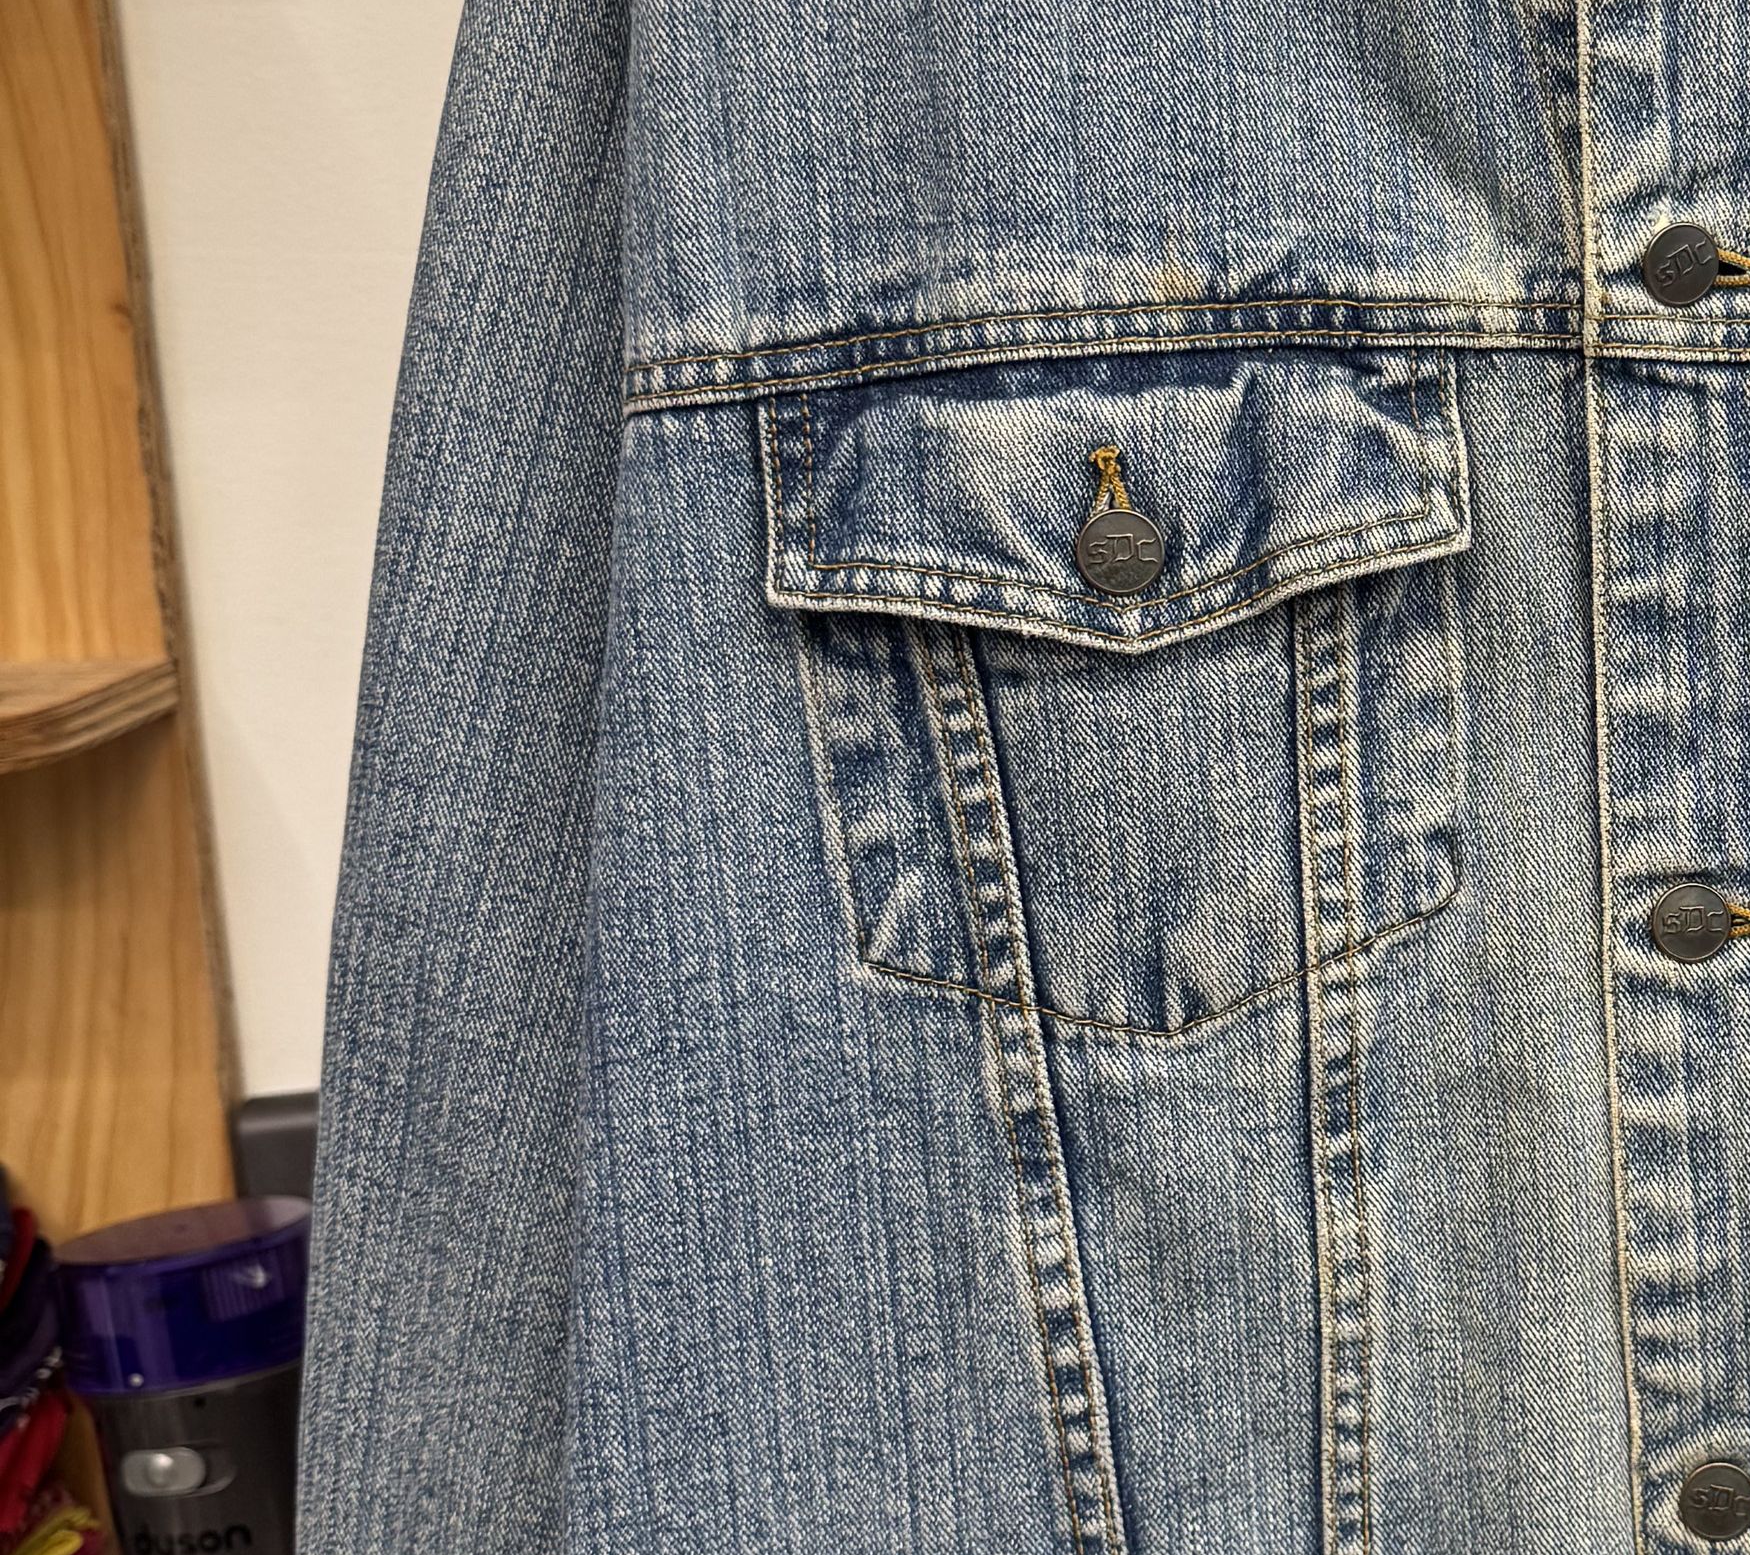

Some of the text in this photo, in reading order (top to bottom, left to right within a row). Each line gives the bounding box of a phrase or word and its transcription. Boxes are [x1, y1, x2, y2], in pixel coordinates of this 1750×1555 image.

[1655, 237, 1713, 287] SDC
[1089, 533, 1159, 565] SDC
[1663, 904, 1725, 935] SDC
